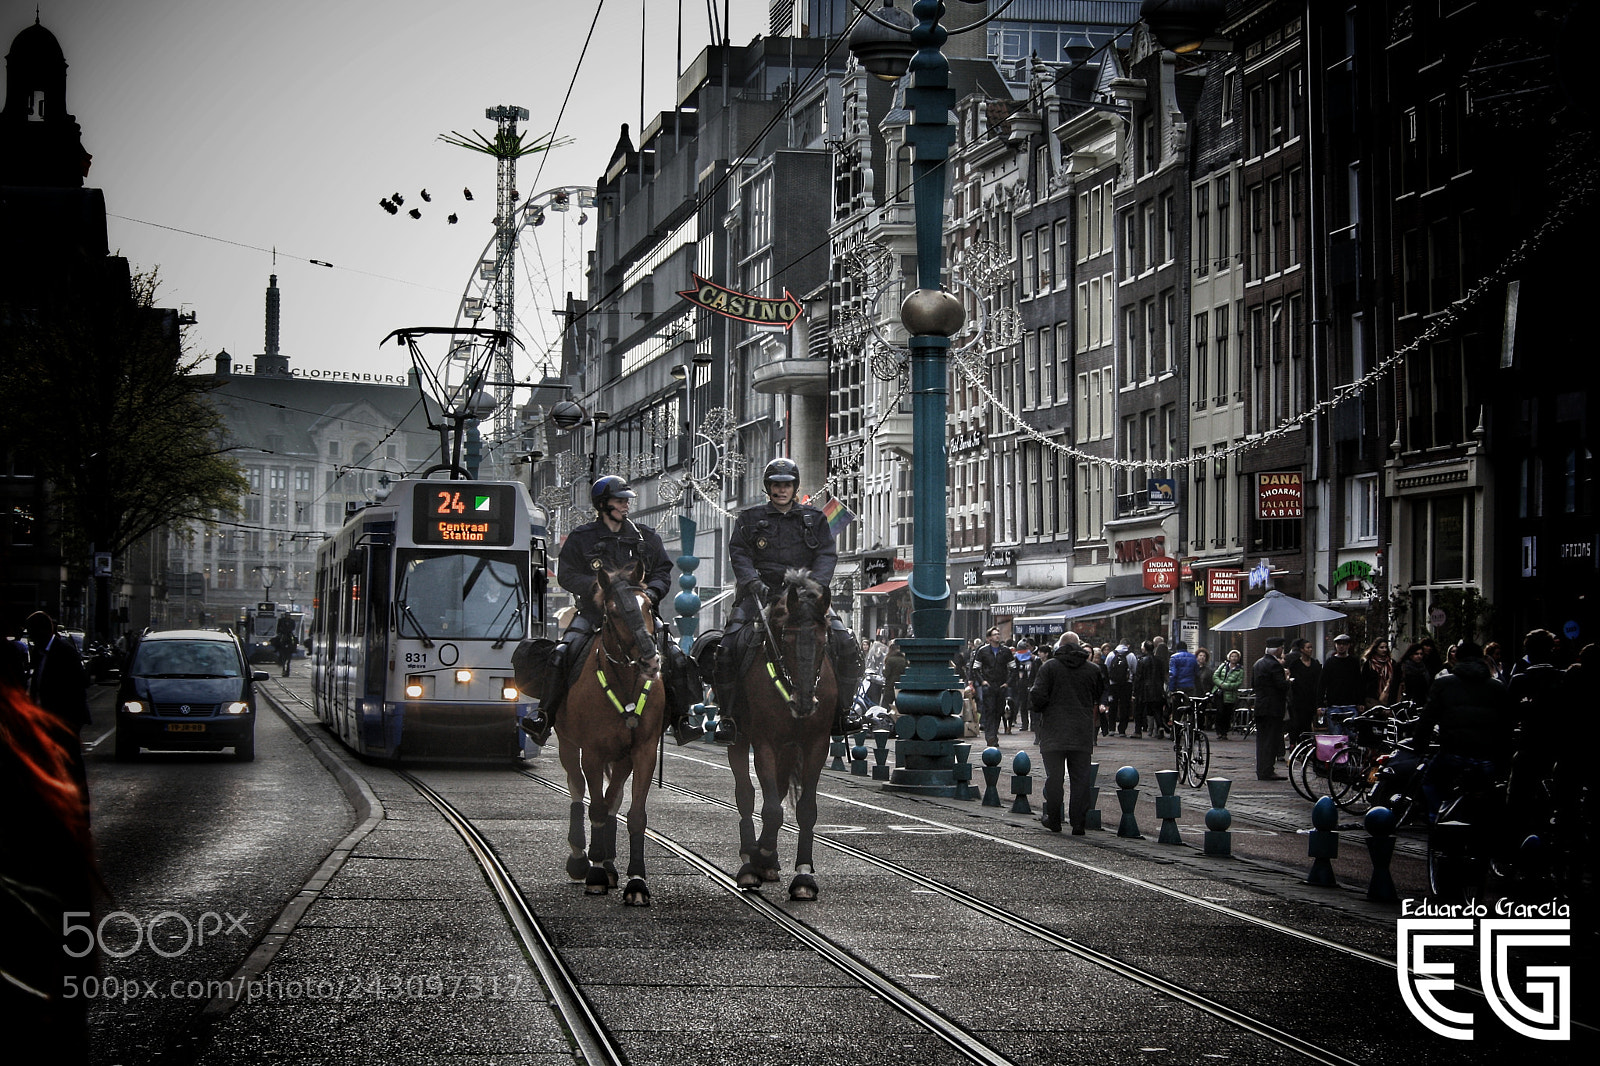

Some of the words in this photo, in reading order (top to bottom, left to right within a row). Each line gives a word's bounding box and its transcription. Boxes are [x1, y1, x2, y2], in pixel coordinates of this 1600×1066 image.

[698, 285, 797, 320] CASINO
[291, 368, 406, 383] CLOPPENBURG
[1260, 474, 1300, 485] DANA
[1260, 488, 1301, 499] SHOARMA
[437, 491, 466, 514] 24
[1261, 500, 1300, 508] FALAFEL
[1261, 508, 1301, 517] KABAB
[438, 521, 489, 533] Centraal
[443, 530, 484, 541] Station
[405, 653, 427, 662] 831
